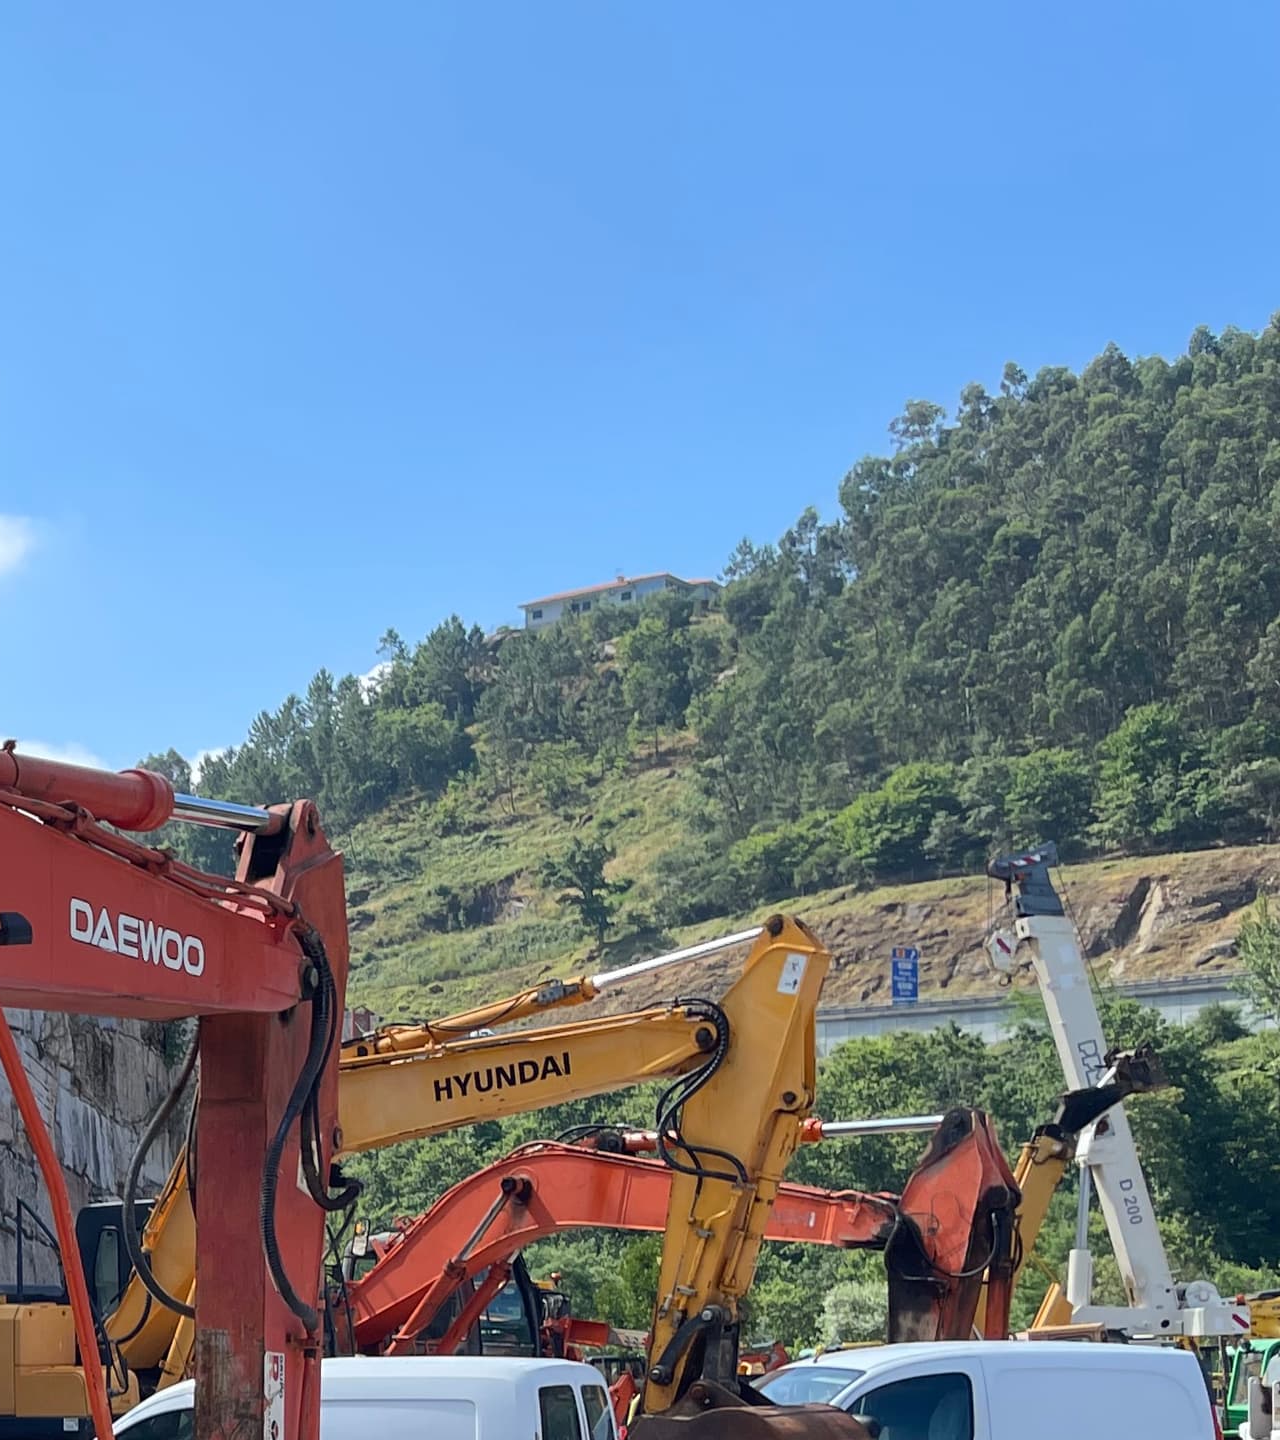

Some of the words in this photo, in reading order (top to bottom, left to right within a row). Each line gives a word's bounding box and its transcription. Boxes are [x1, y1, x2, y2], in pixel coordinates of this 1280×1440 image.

[69, 897, 206, 977] DAEWOO
[433, 1051, 571, 1102] HYUNDAI
[1119, 1178, 1134, 1192] D
[1124, 1197, 1143, 1225] 200
